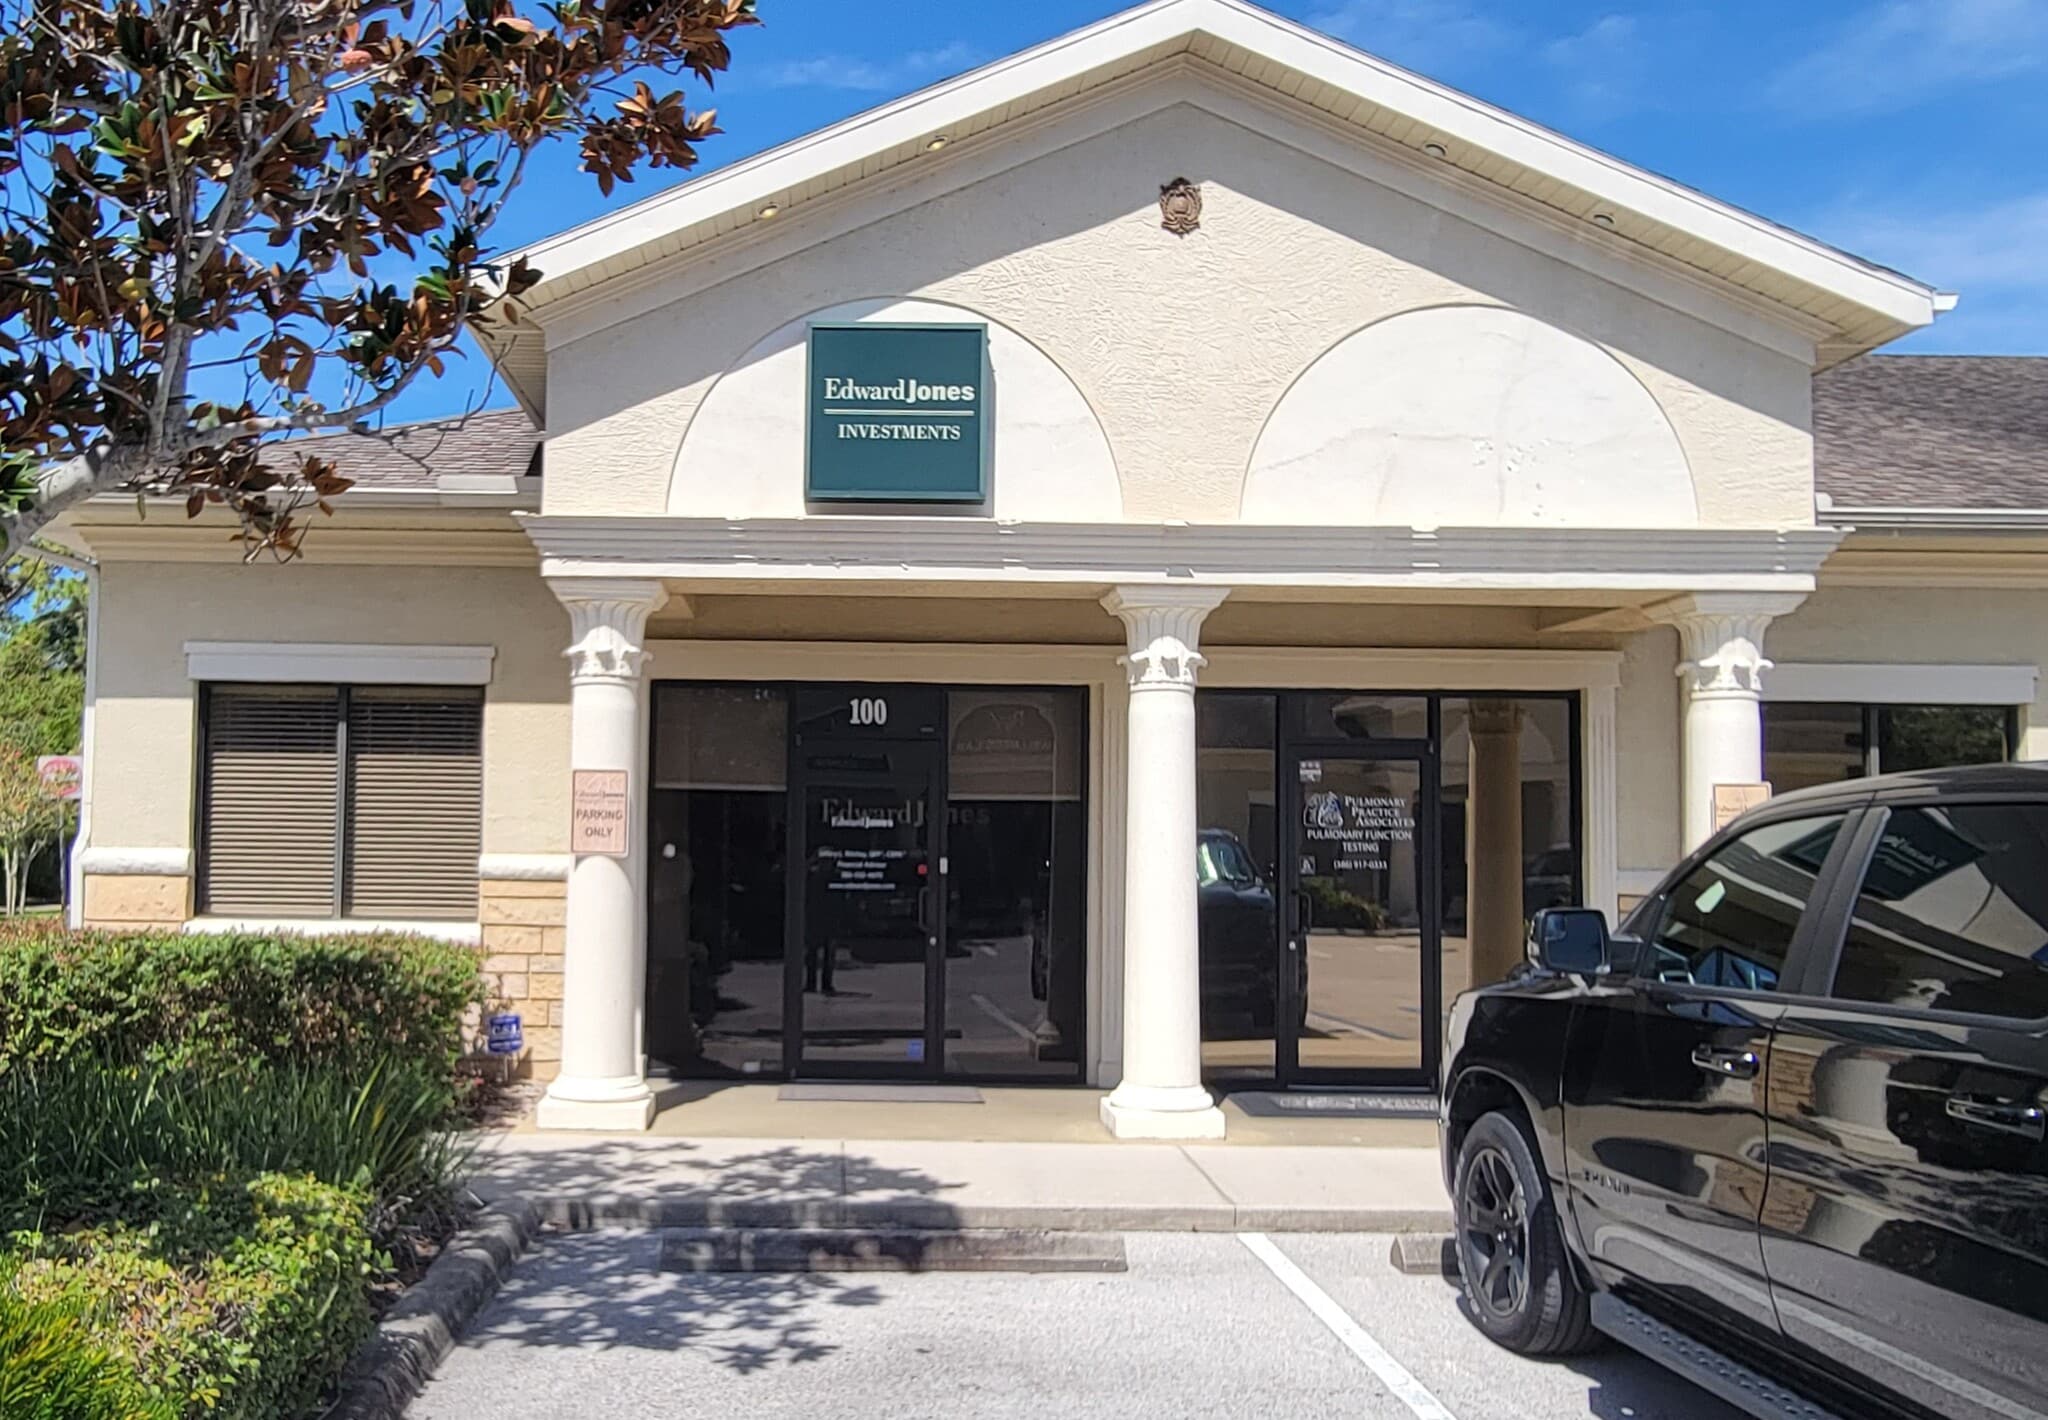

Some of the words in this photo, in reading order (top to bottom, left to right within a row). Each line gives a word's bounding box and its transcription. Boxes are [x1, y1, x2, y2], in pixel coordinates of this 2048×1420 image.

[838, 424, 960, 440] INVESTMENTS
[849, 698, 888, 725] 100
[1345, 796, 1405, 807] PULMONARY
[576, 809, 623, 820] PARKING
[1352, 807, 1399, 817] PRACTICE
[1356, 817, 1415, 827] ASSOCIATES
[585, 827, 613, 837] ONLY
[1307, 829, 1363, 840] PULMONARY
[1365, 830, 1412, 840] FUNCTION
[1342, 841, 1379, 852] TESTING
